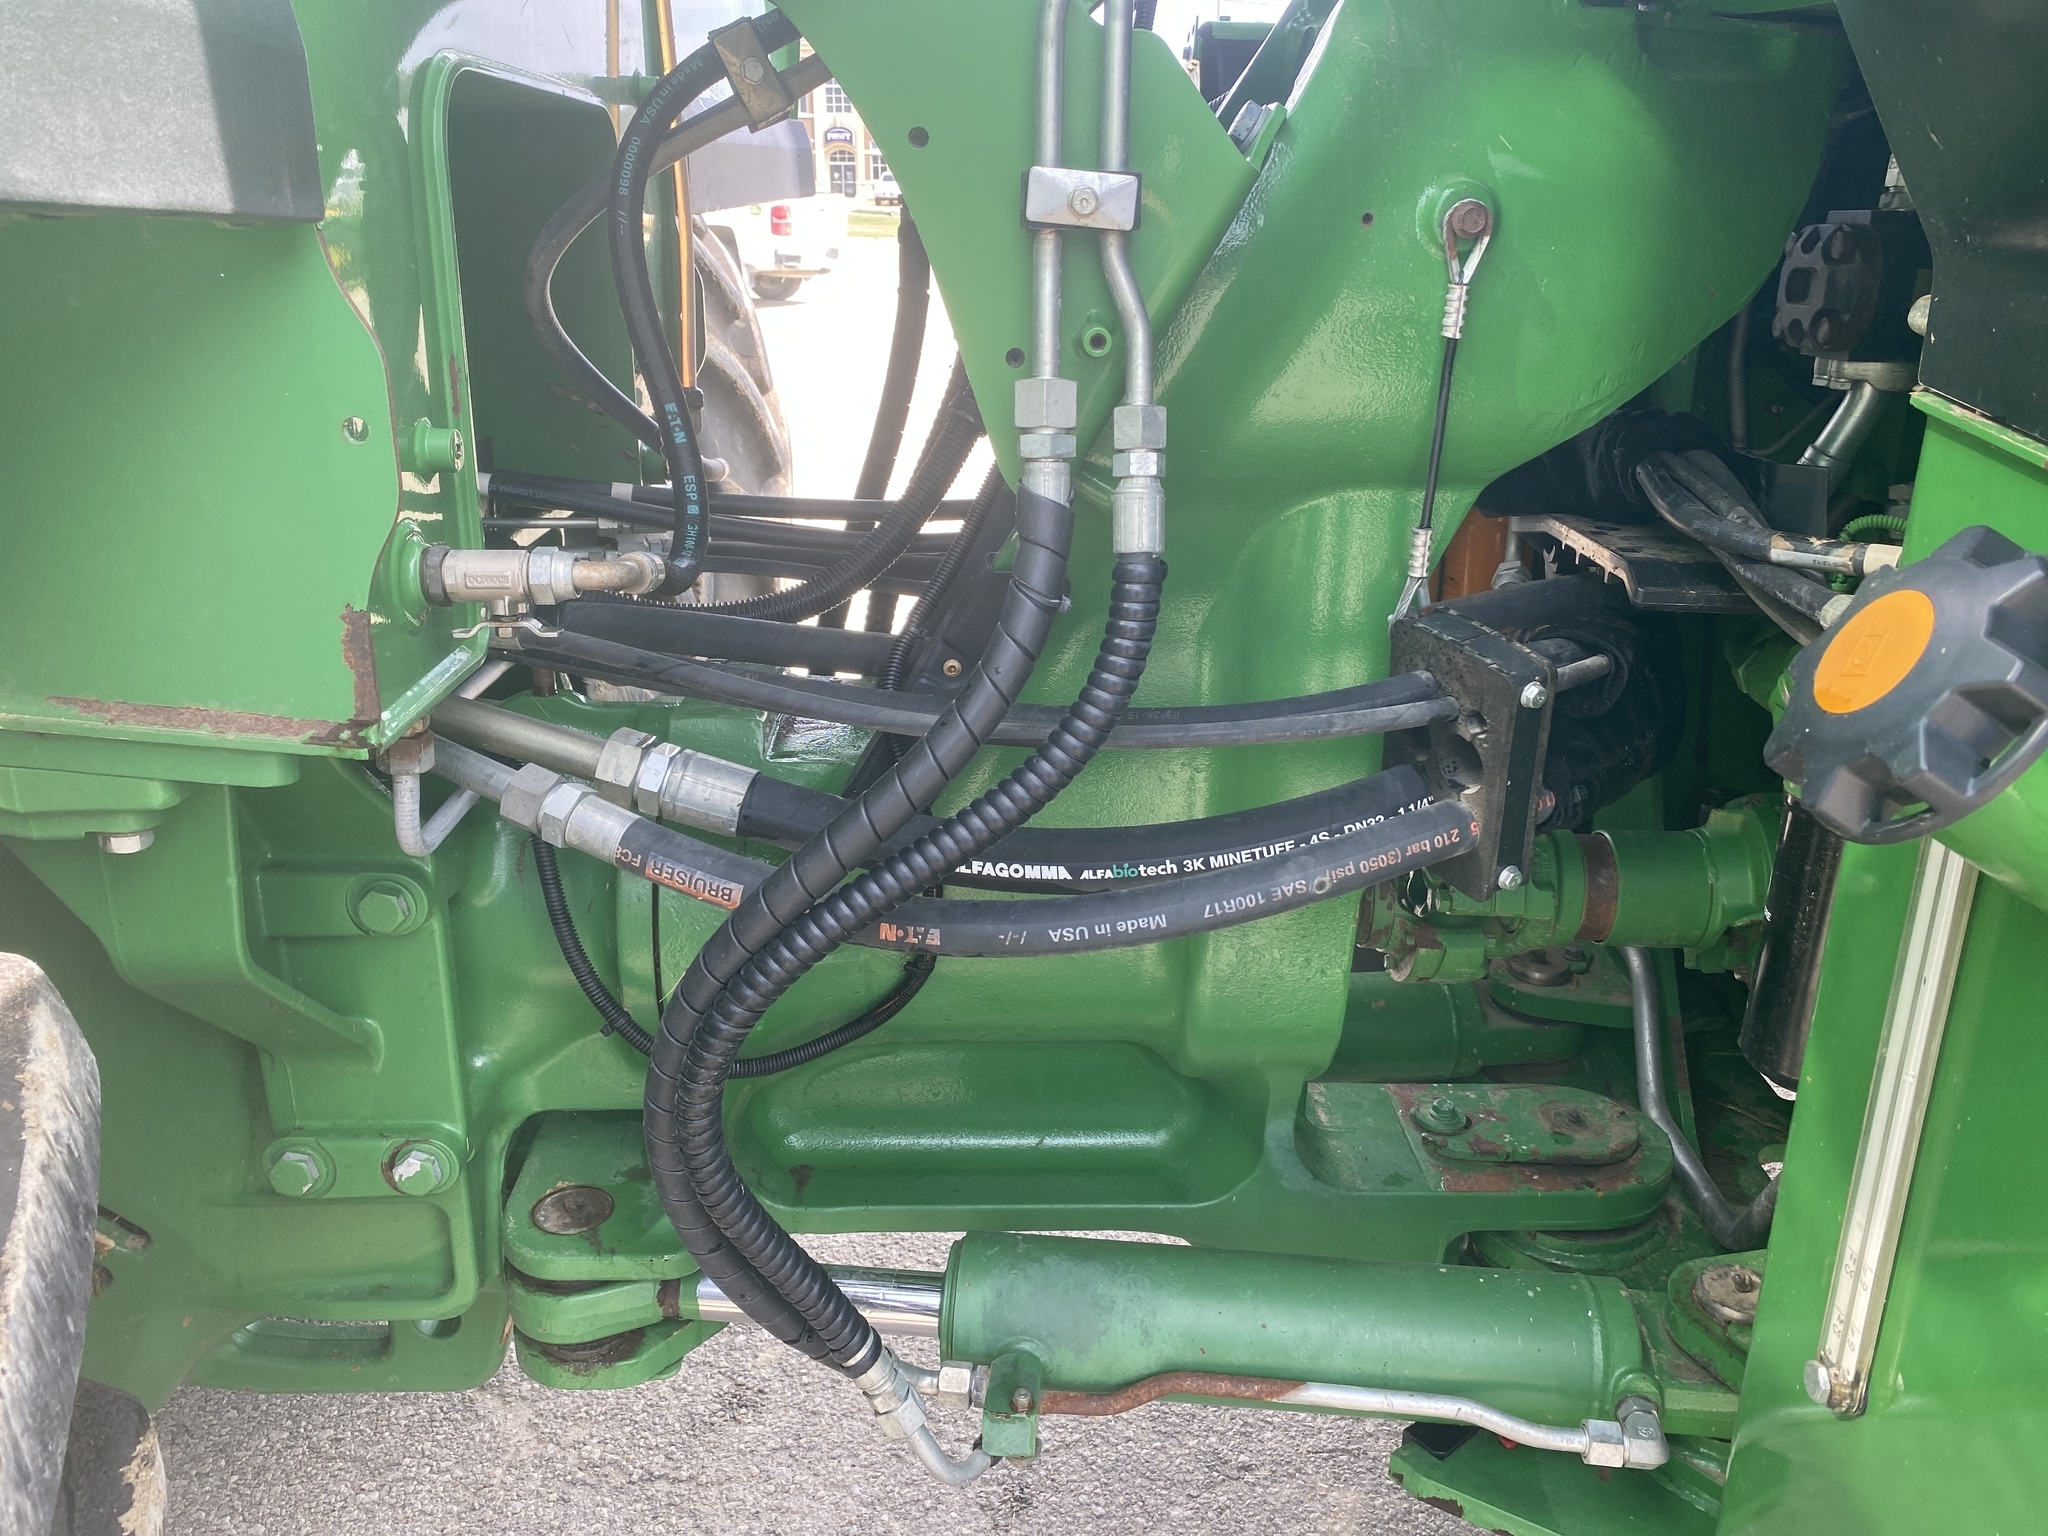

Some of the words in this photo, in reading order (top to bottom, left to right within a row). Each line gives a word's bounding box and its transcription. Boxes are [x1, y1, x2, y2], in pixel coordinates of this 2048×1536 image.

[673, 57, 704, 85] Made
[662, 86, 674, 97] in
[640, 95, 664, 125] USA
[618, 136, 641, 196] 0000098
[683, 474, 698, 501] ESP
[1182, 857, 1206, 872] 3K
[1209, 839, 1295, 868] MINETUFF
[1309, 831, 1331, 845] 4S
[1405, 839, 1431, 857] bar
[1434, 828, 1460, 848] 210
[1359, 847, 1402, 874] (3050
[651, 857, 734, 903] BRUISER
[1270, 879, 1307, 901] SAE
[1204, 891, 1266, 919] 100R17
[1048, 926, 1089, 943] USA
[1094, 924, 1112, 937] in
[1116, 913, 1168, 934] Made
